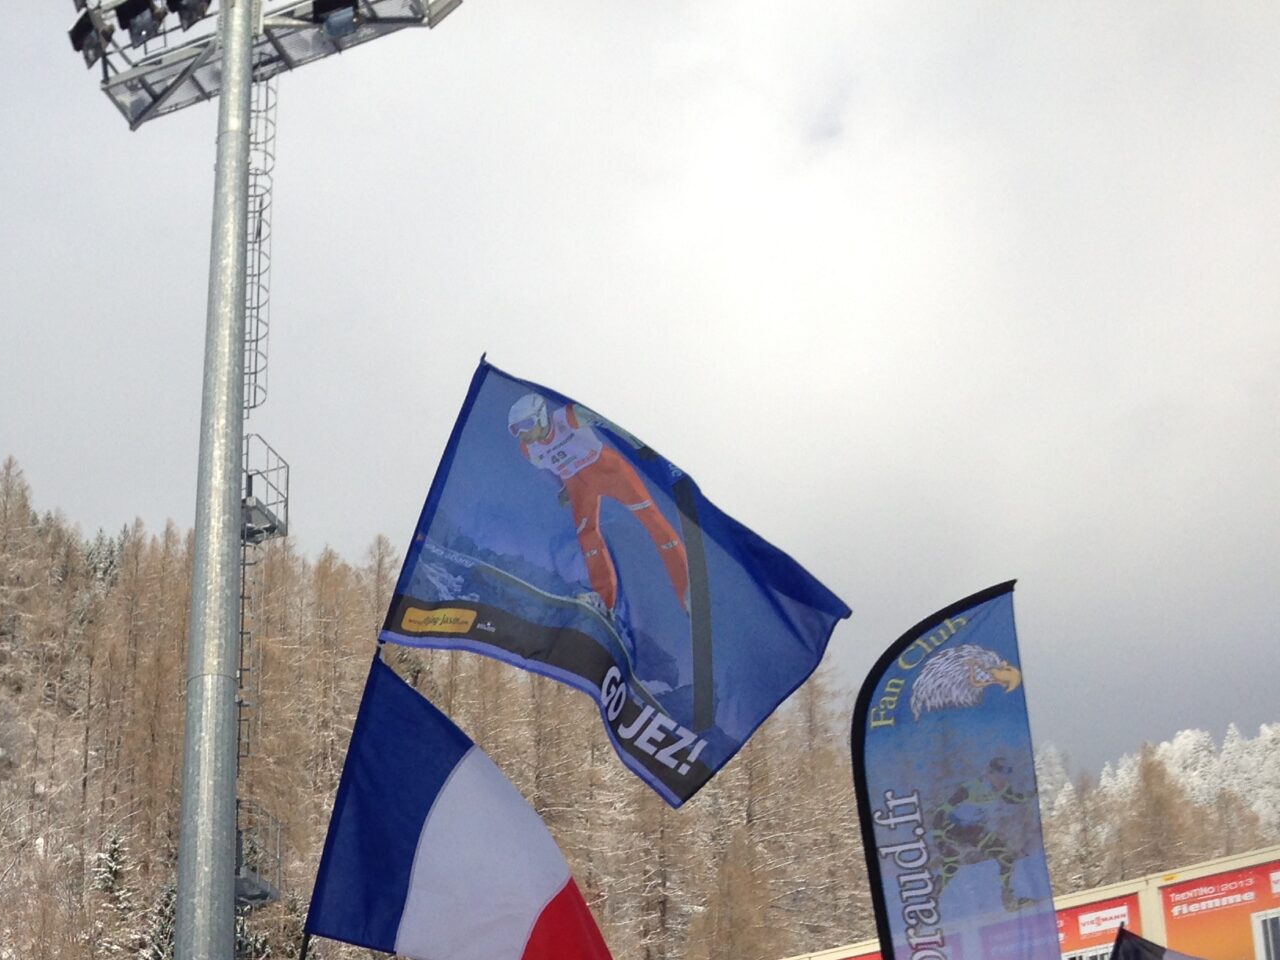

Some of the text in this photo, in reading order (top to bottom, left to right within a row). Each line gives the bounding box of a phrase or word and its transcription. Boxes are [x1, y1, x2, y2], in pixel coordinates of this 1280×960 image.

[871, 616, 968, 729] Fan Club
[601, 666, 709, 776] GO JEZ!
[1171, 891, 1256, 917] fiemme
[1220, 878, 1255, 892] 2013
